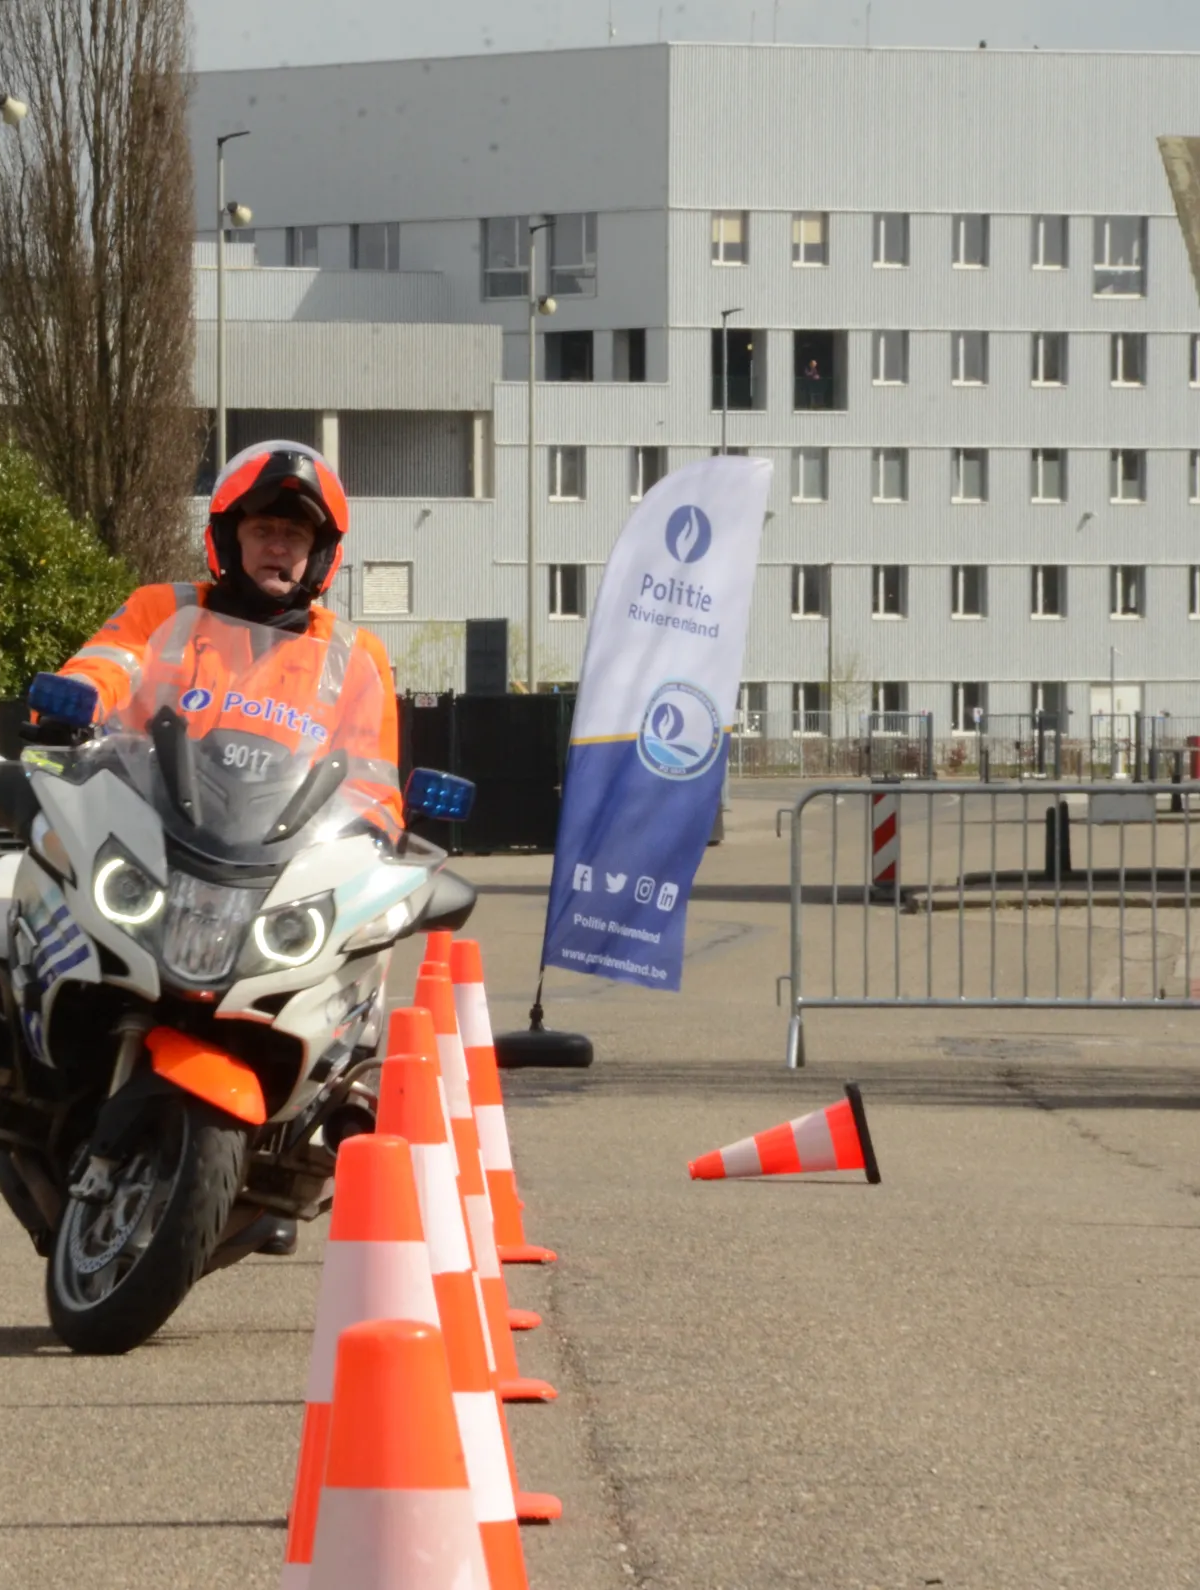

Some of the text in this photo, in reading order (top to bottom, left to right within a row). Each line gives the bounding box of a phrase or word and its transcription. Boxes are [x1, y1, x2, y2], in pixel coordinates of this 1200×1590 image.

[640, 573, 712, 613] Politie
[224, 692, 328, 743] Politie
[223, 743, 272, 773] 9017
[573, 912, 607, 932] Politie
